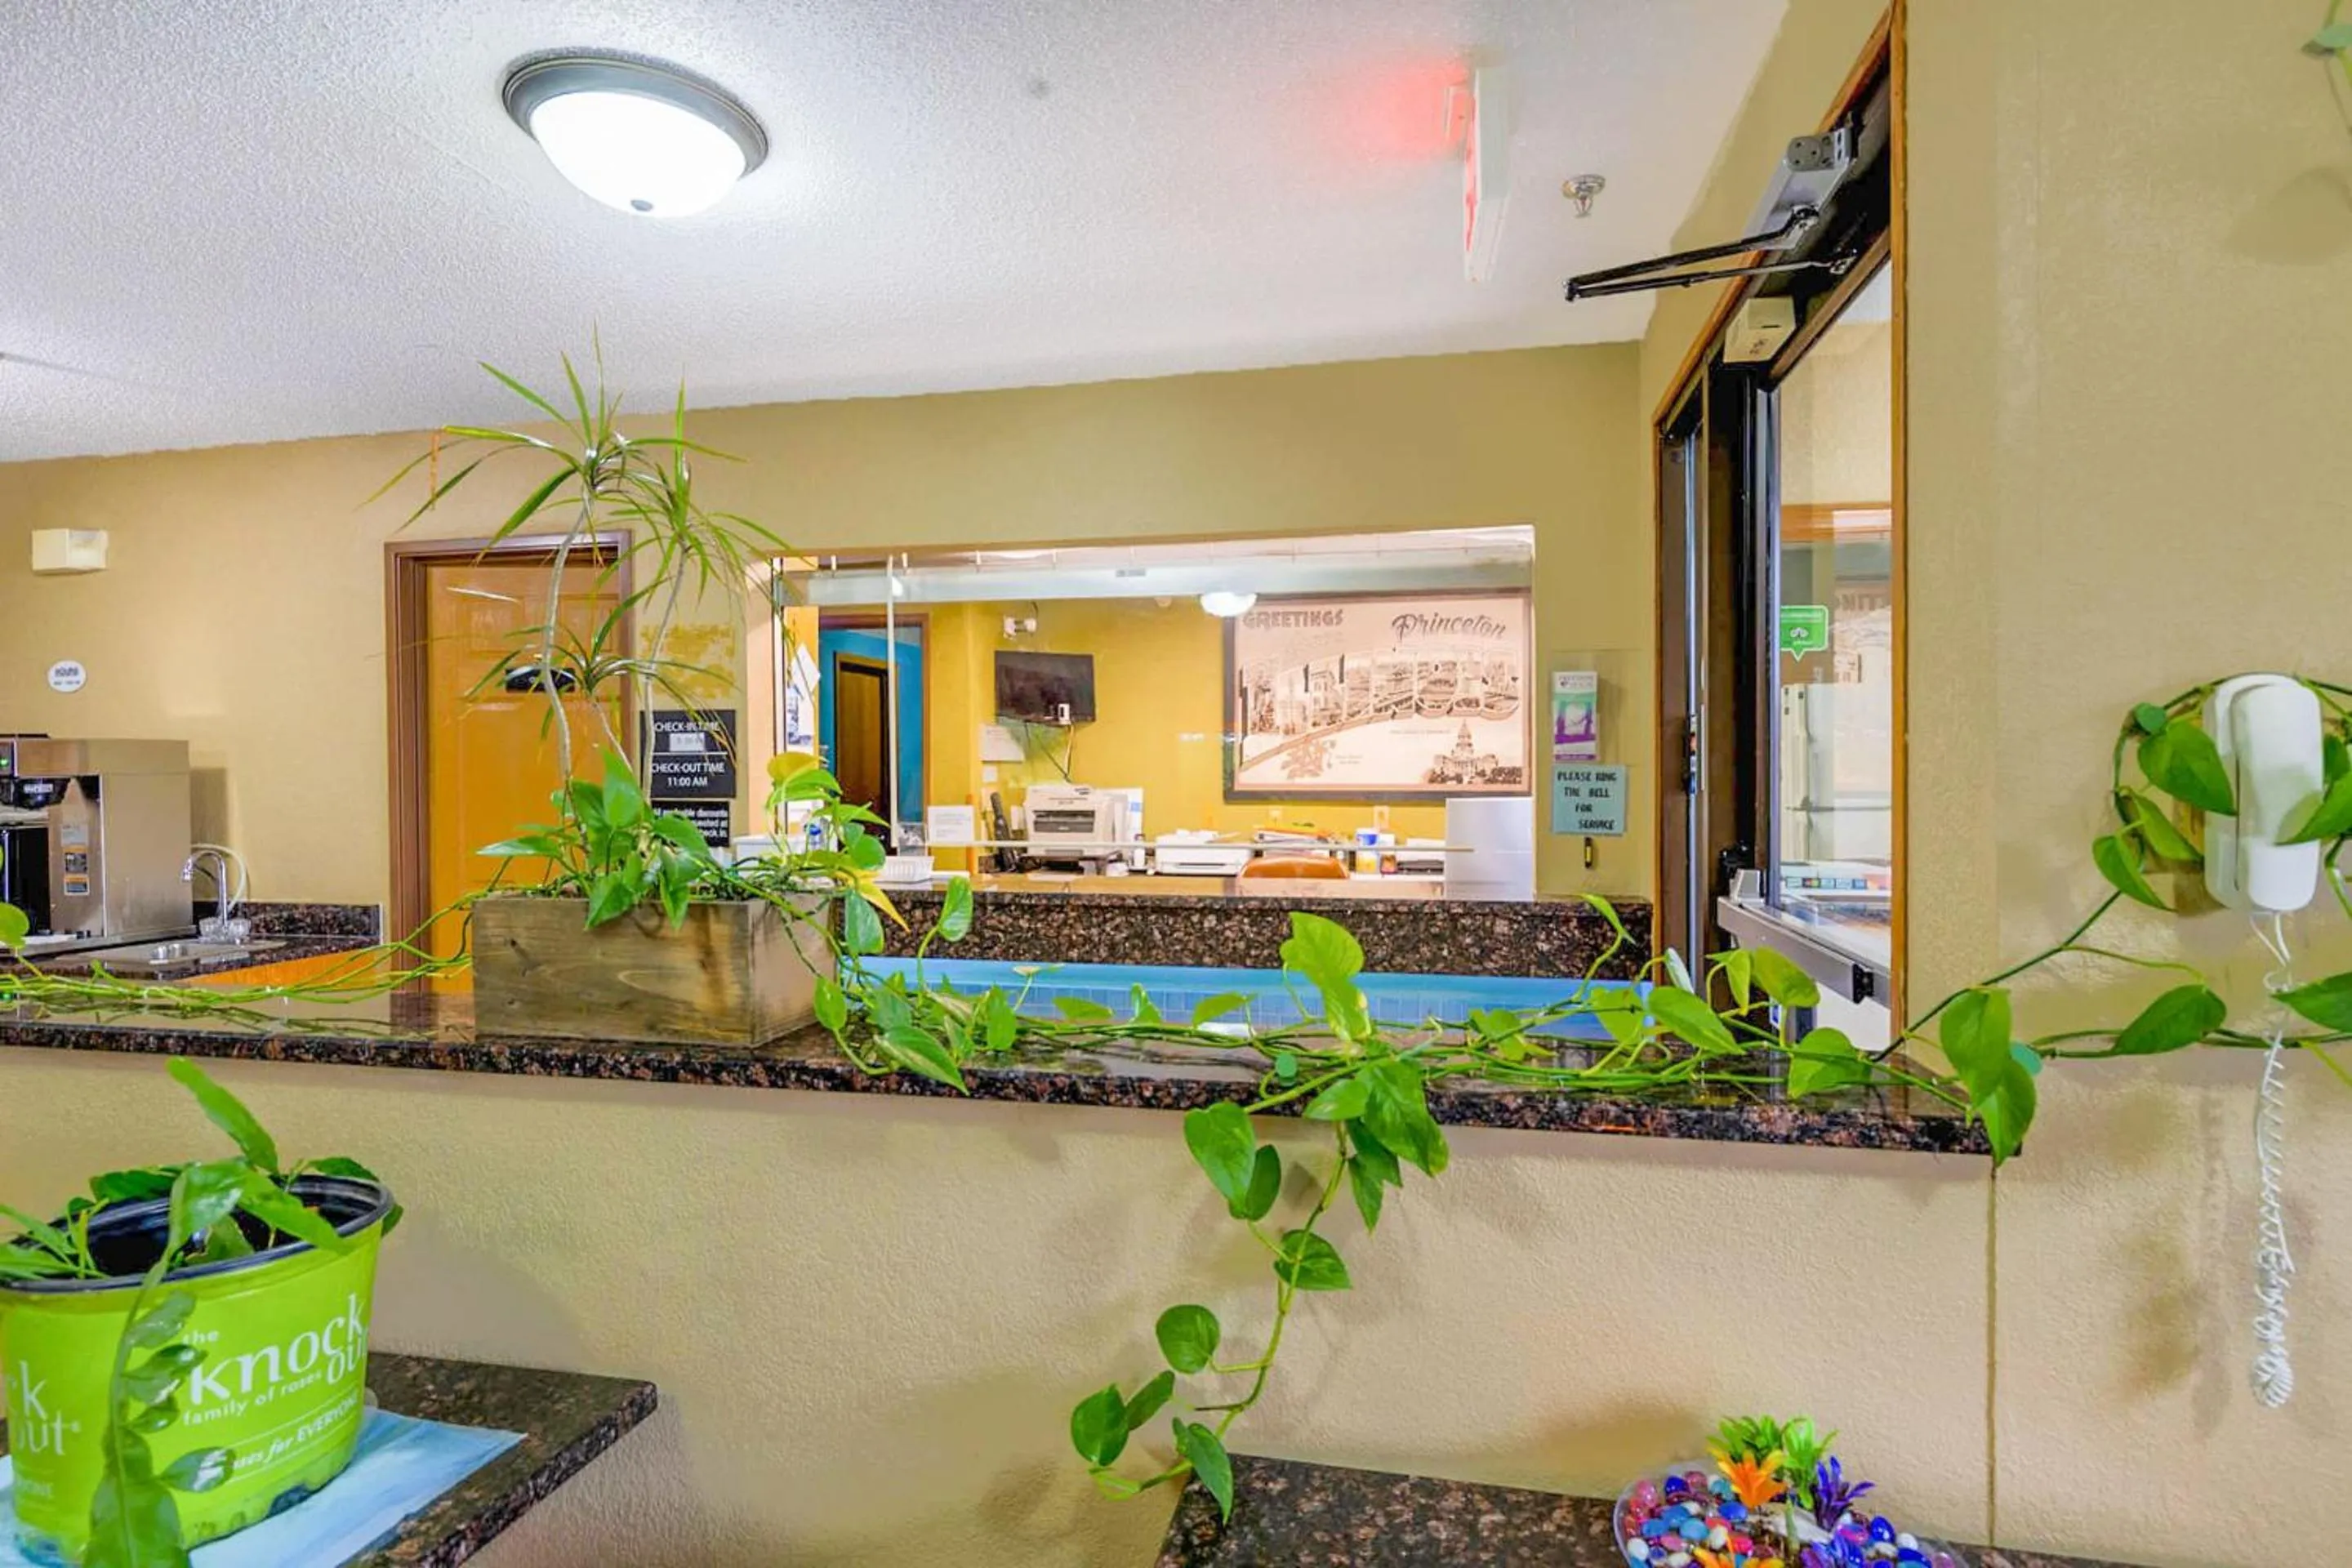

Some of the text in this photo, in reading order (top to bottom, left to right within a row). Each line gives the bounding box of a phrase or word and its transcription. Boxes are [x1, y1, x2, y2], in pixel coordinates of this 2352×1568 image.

[1241, 609, 1344, 630] GREETINGS
[1392, 612, 1507, 641] Princeton
[652, 762, 725, 774] CHECK-OUT TIME
[667, 777, 708, 787] 11:00 AM
[1557, 771, 1592, 782] PLEASE
[1564, 786, 1610, 798] THE BELL
[1575, 803, 1593, 813] FOR
[1578, 818, 1615, 831] SERVICE
[183, 1330, 219, 1347] the
[183, 1398, 248, 1426] family
[255, 1386, 275, 1405] of
